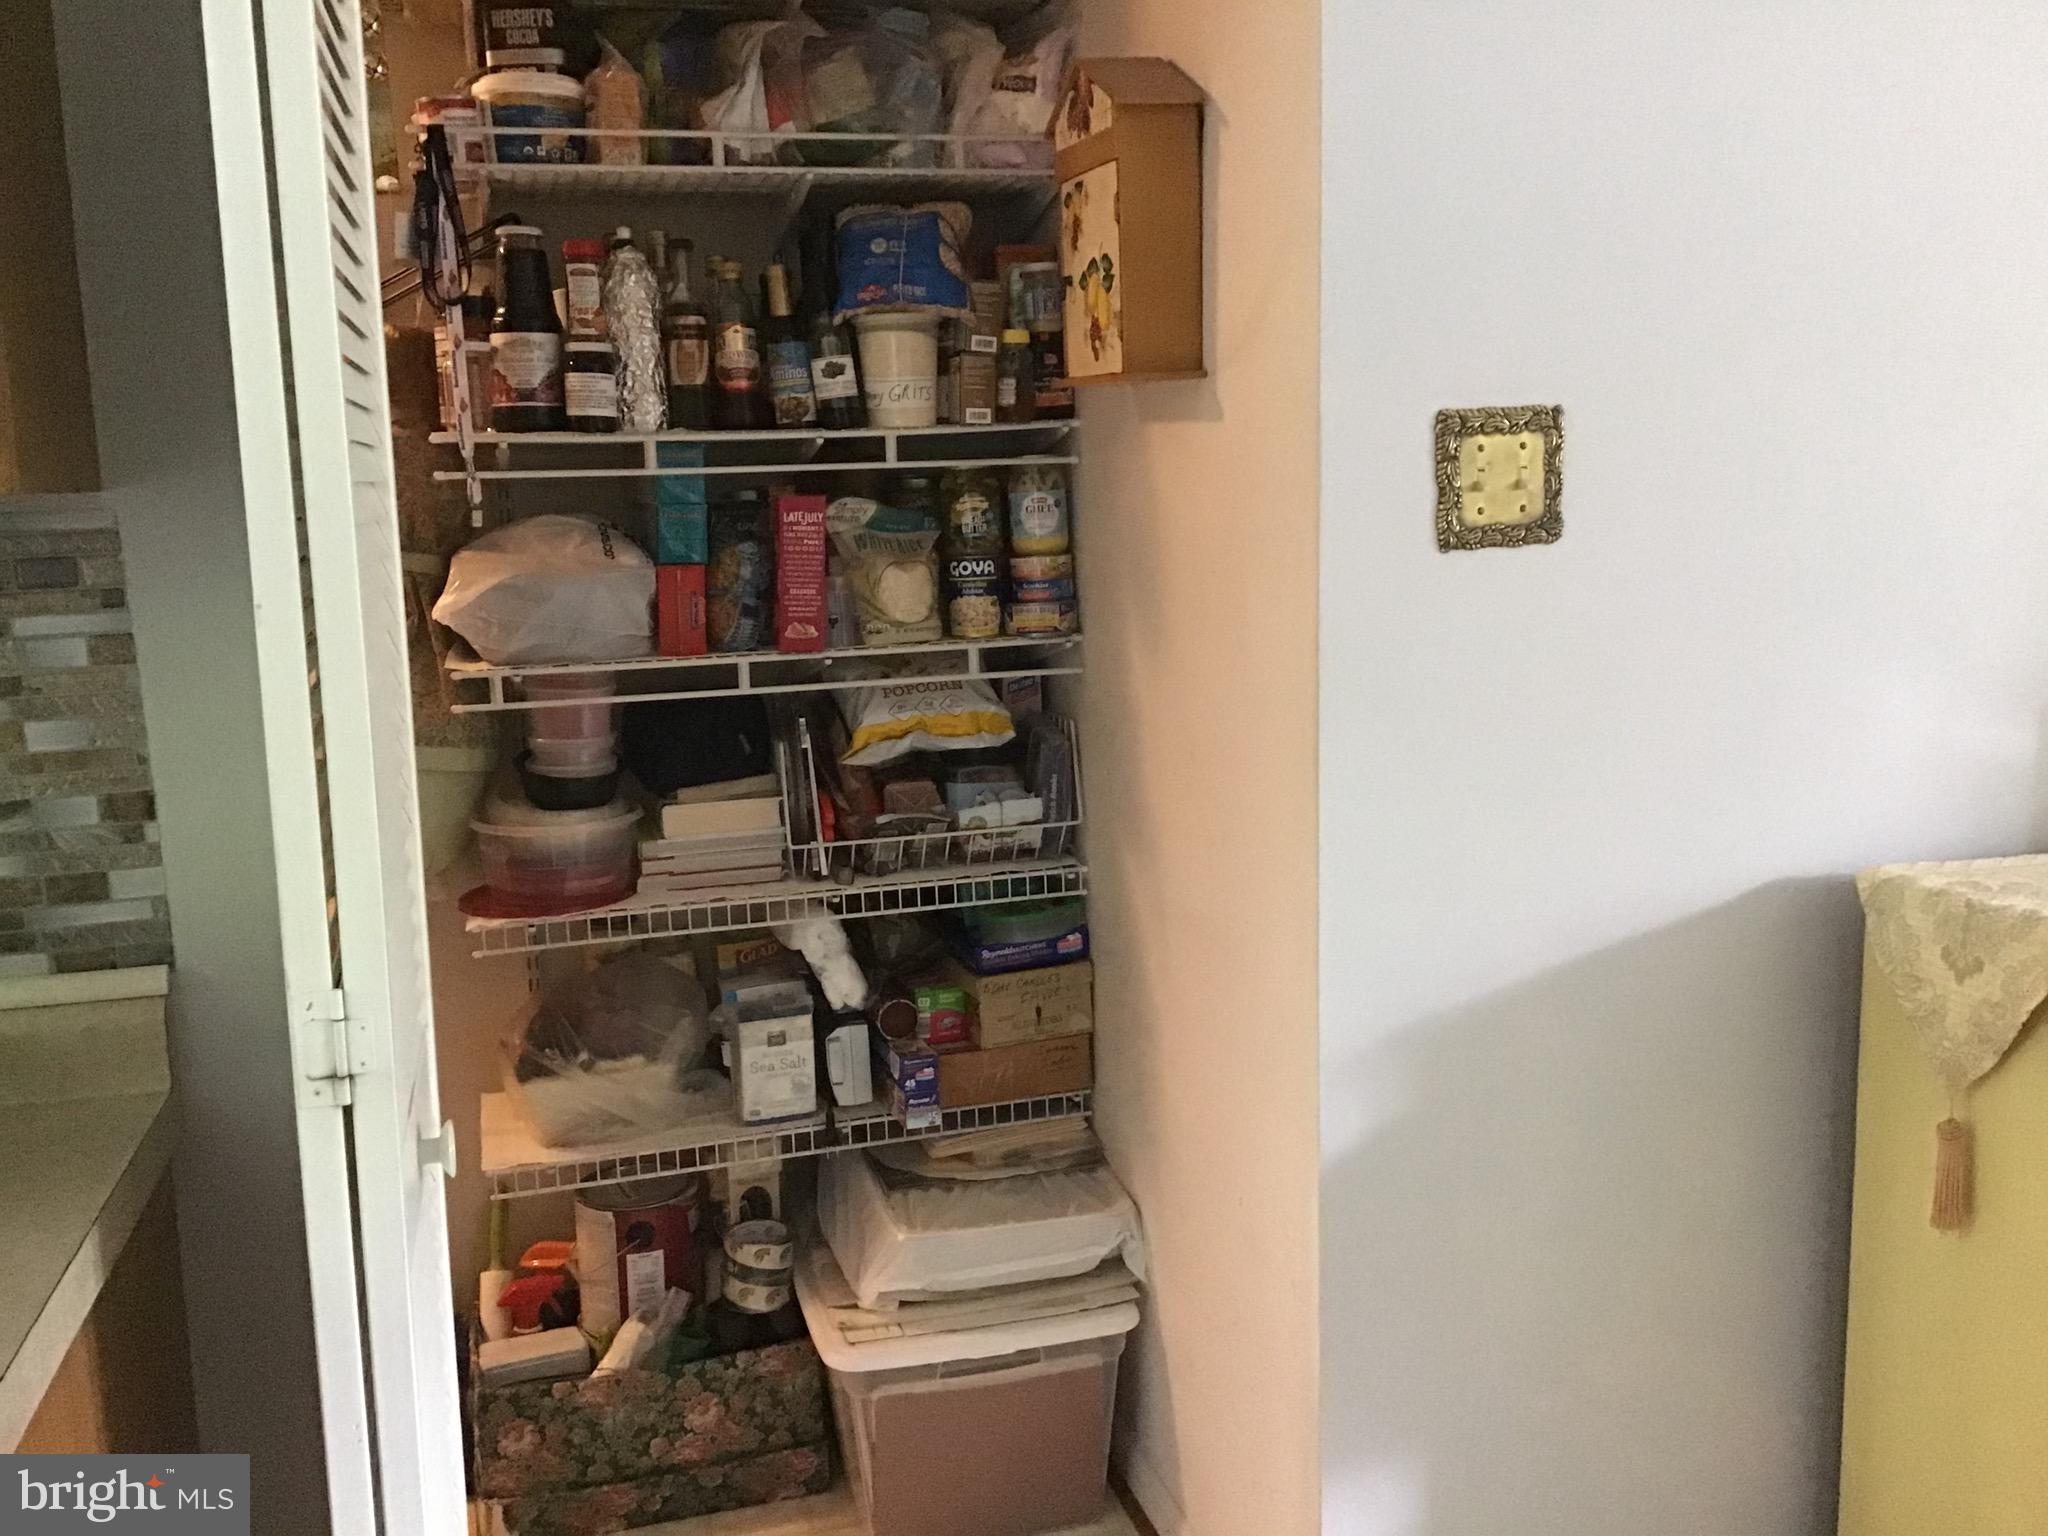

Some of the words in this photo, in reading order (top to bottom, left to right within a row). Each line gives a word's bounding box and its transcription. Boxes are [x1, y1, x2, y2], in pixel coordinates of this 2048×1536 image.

[491, 8, 554, 28] HERSHEY'S
[506, 28, 540, 44] COCOA
[949, 560, 995, 577] GOYA
[882, 679, 963, 699] POPCORN
[739, 943, 778, 964] GLAD
[750, 1060, 776, 1074] Sea
[779, 1055, 807, 1071] Salt
